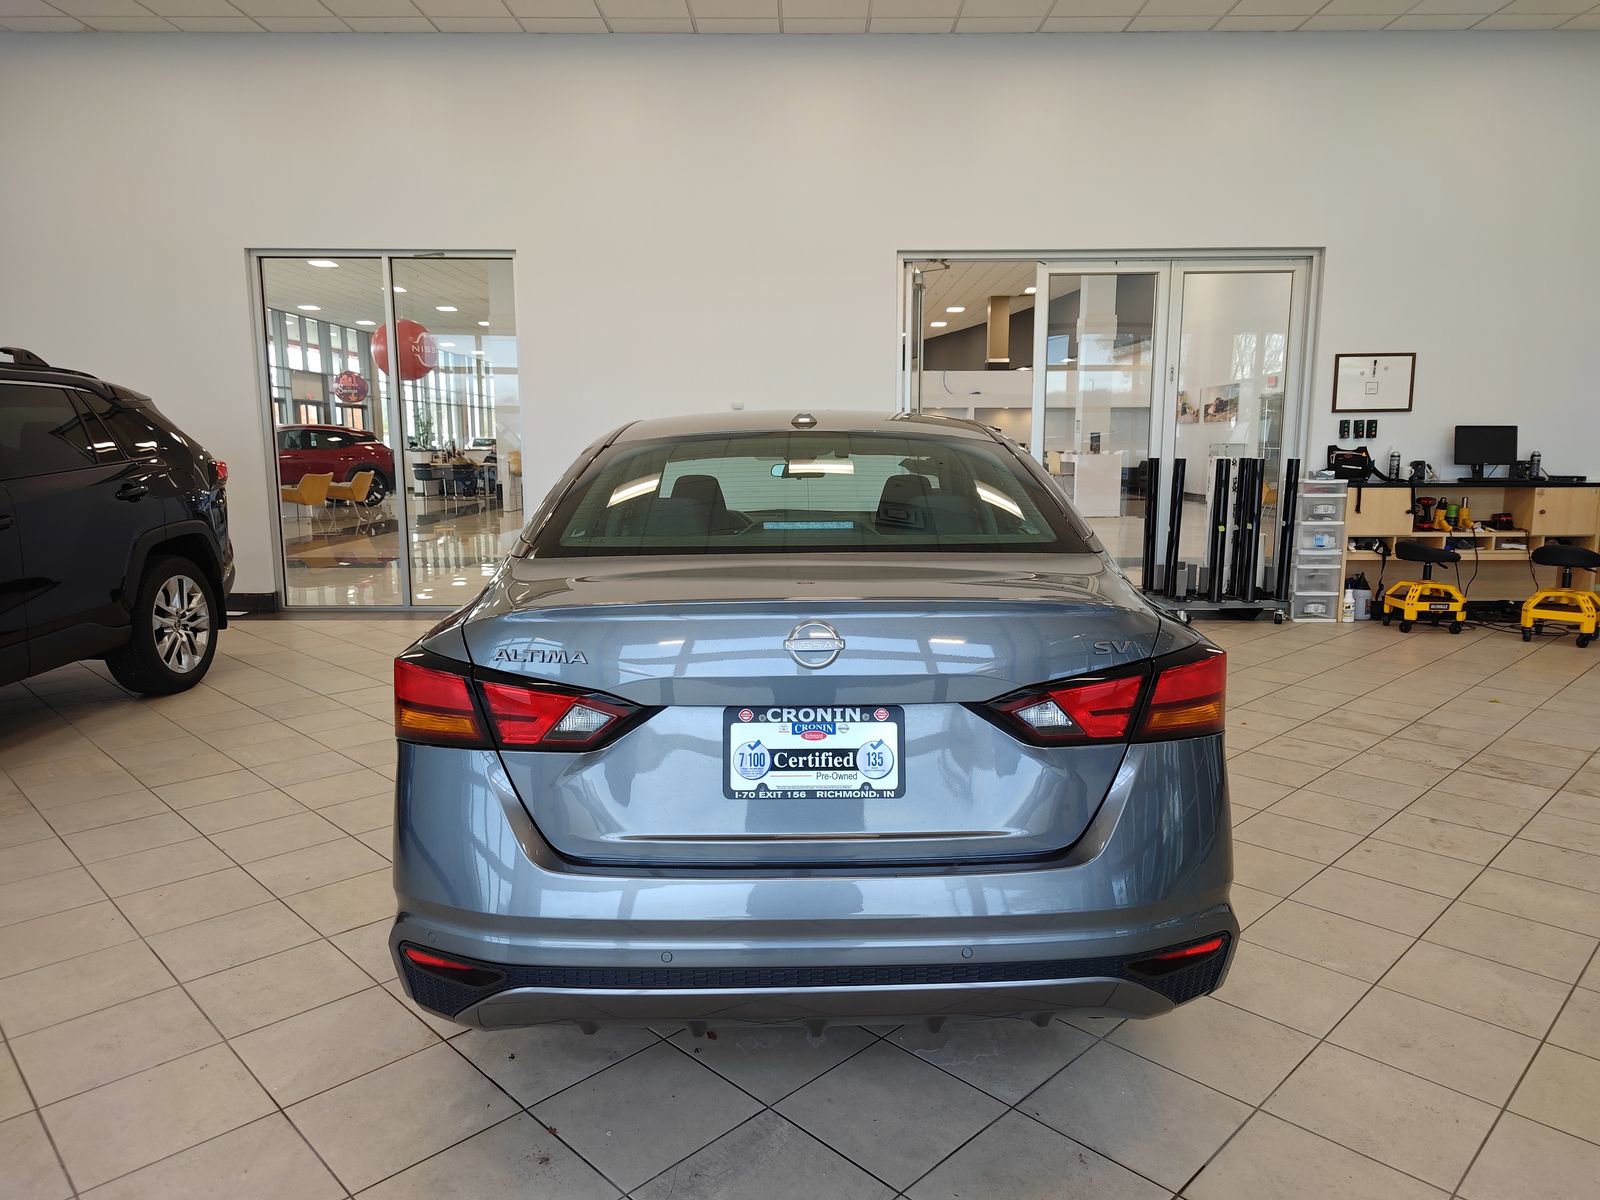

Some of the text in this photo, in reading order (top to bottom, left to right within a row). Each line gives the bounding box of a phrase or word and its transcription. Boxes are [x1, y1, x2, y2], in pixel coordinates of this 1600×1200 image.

[785, 640, 845, 650] NISSAN
[1094, 640, 1131, 655] SV
[493, 648, 589, 665] ALTIMA
[766, 708, 861, 723] CRONIN
[794, 724, 834, 734] CRONIN
[773, 751, 855, 768] Certified
[866, 751, 884, 767] 135
[816, 772, 858, 780] Pre-Owned
